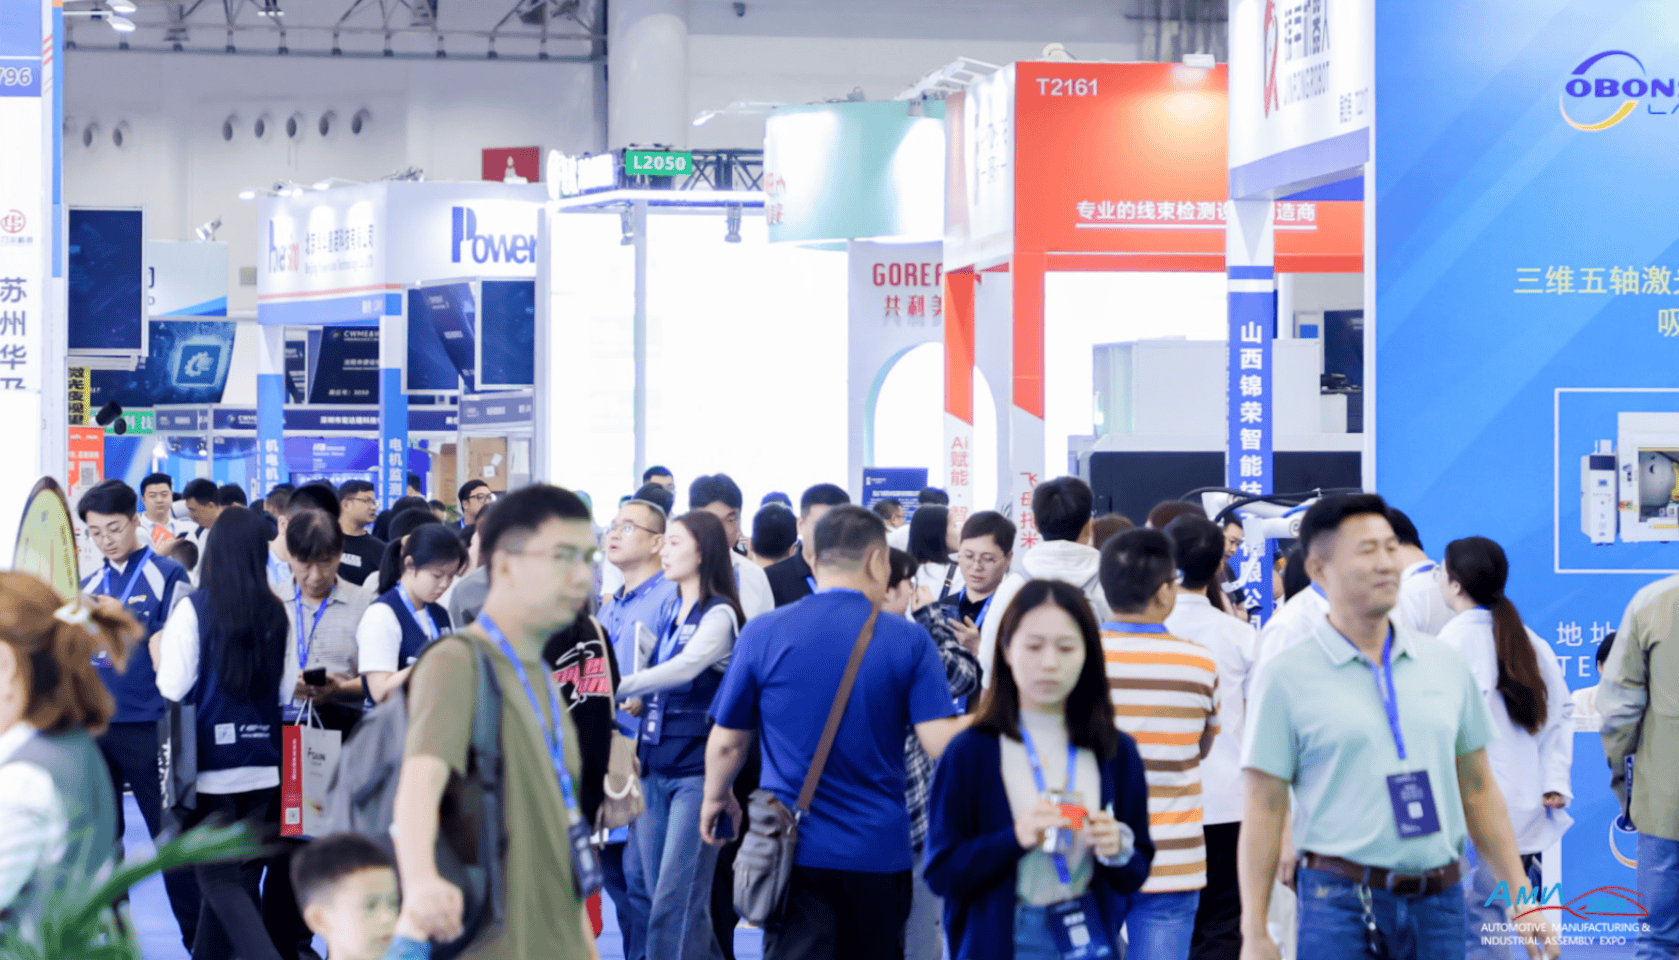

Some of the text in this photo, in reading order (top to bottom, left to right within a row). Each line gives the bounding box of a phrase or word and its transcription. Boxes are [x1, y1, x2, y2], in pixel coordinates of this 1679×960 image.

[1035, 77, 1099, 96] T2161
[1565, 78, 1679, 98] OBON
[633, 154, 687, 171] L2050
[451, 206, 537, 264] Power
[1513, 265, 1679, 296] 三维五轴激
